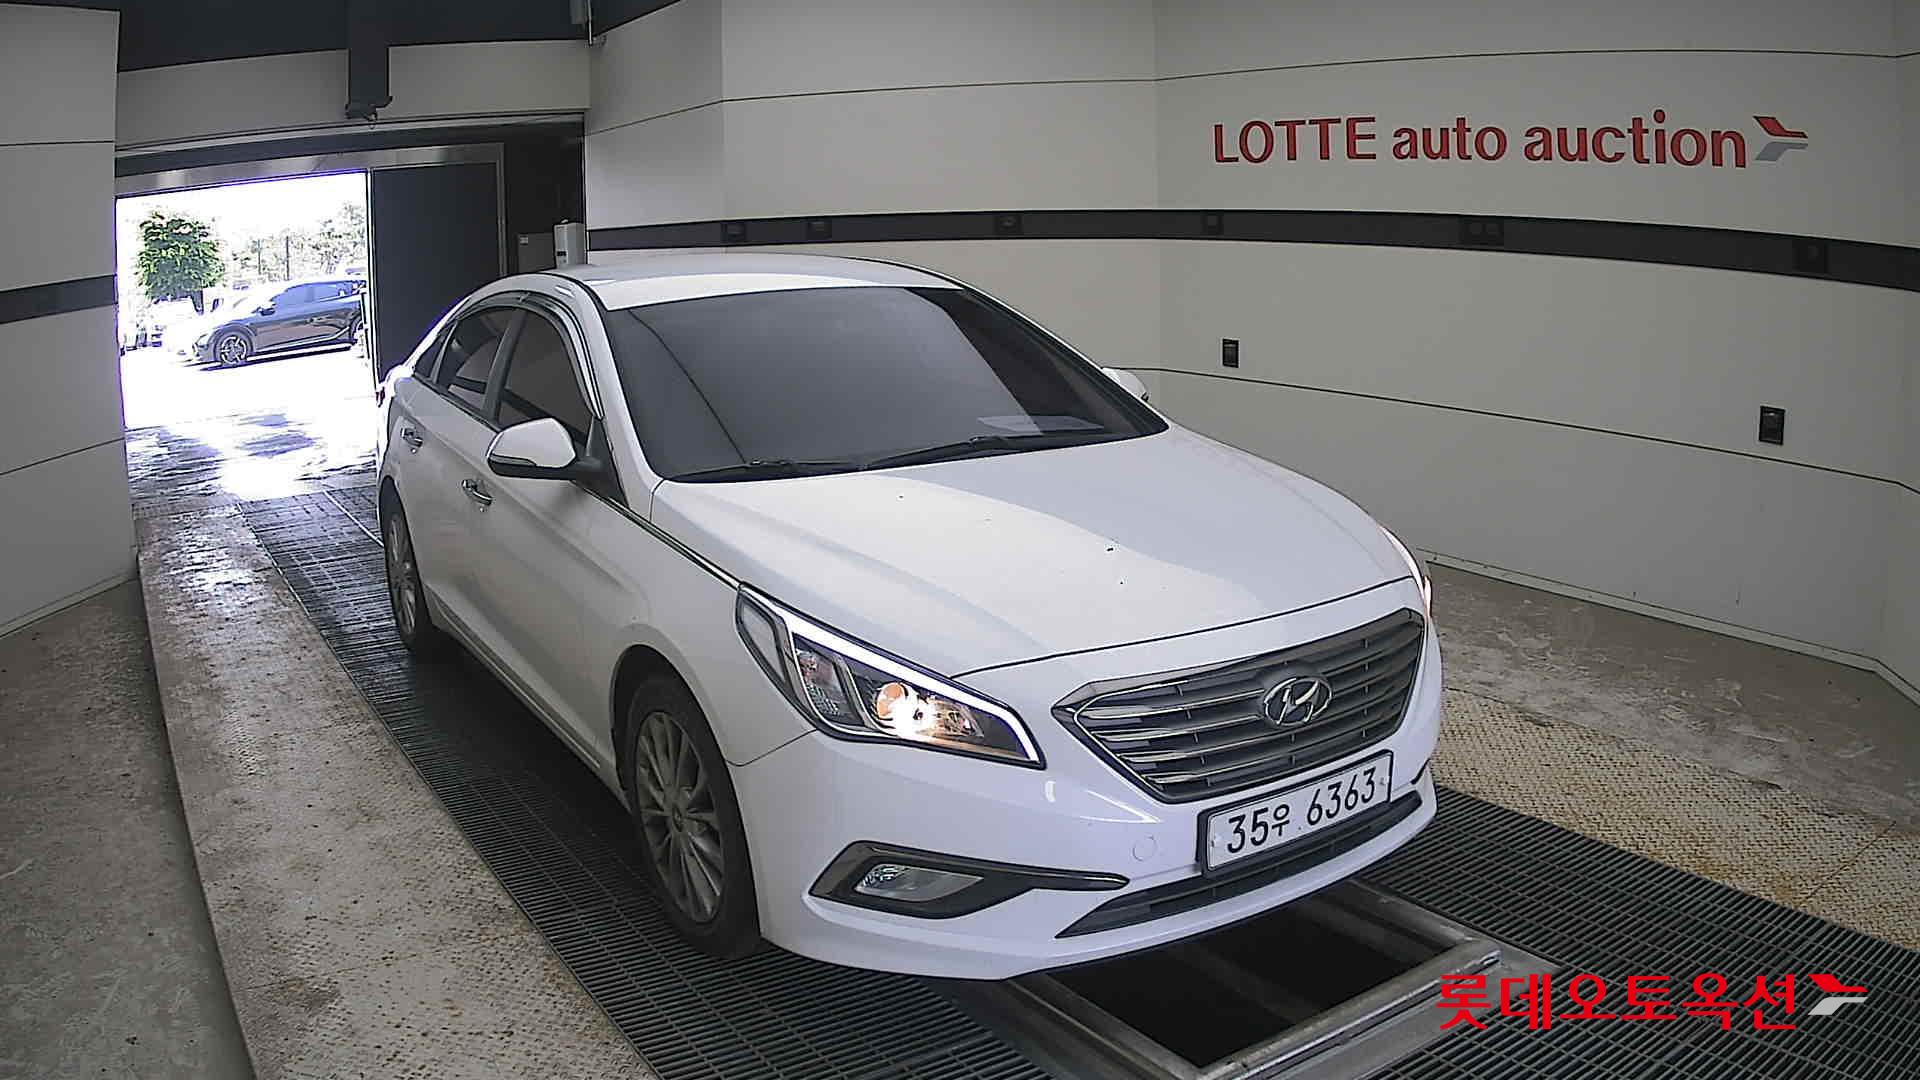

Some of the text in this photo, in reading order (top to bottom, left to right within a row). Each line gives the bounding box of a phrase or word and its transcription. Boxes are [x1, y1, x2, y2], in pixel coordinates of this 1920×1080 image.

[1214, 109, 1747, 169] LOTTE auto auction
[1227, 766, 1376, 854] 35우 6363
